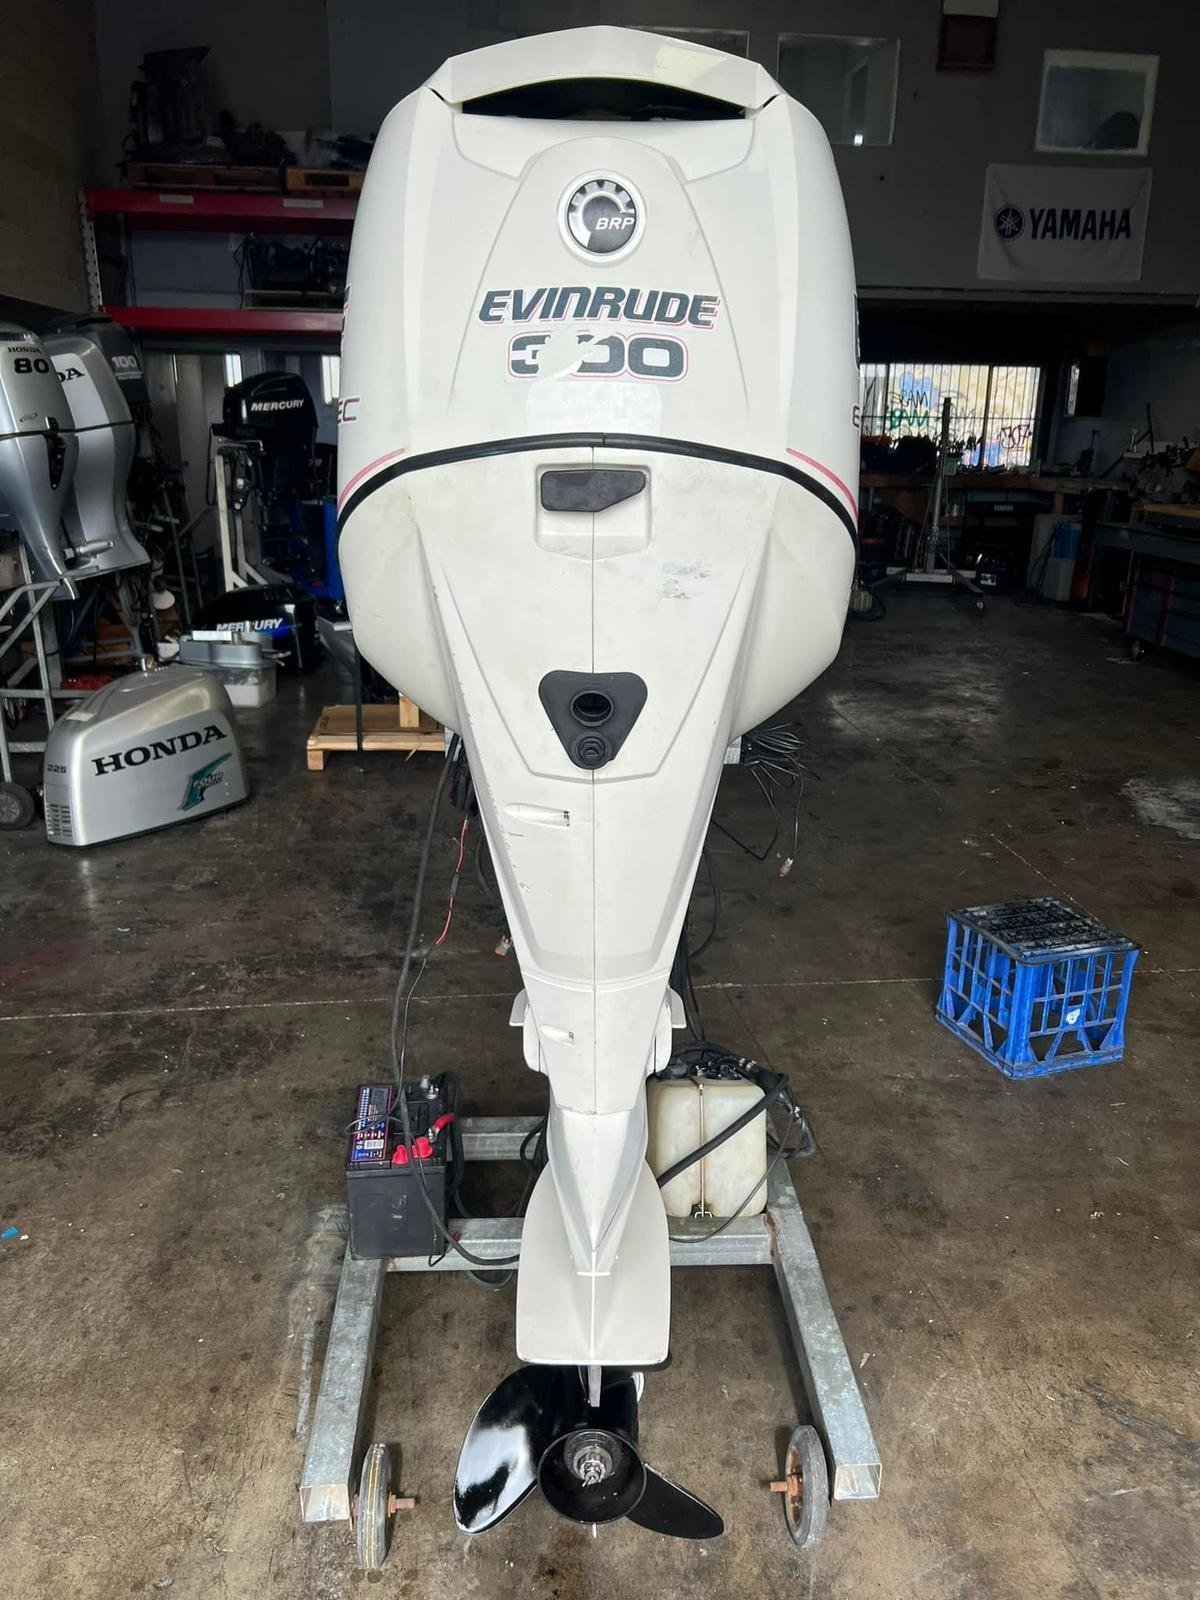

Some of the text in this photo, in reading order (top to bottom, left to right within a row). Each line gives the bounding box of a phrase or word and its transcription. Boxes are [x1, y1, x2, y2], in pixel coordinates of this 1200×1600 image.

[595, 217, 635, 230] BRP
[1029, 207, 1132, 241] YAMAHA
[479, 286, 721, 329] EVINRUDE
[8, 346, 41, 354] HONDA
[14, 358, 49, 374] 80
[112, 355, 138, 369] 100
[251, 399, 304, 412] MERCURY
[216, 618, 283, 632] MERURY
[91, 724, 227, 776] HONDA
